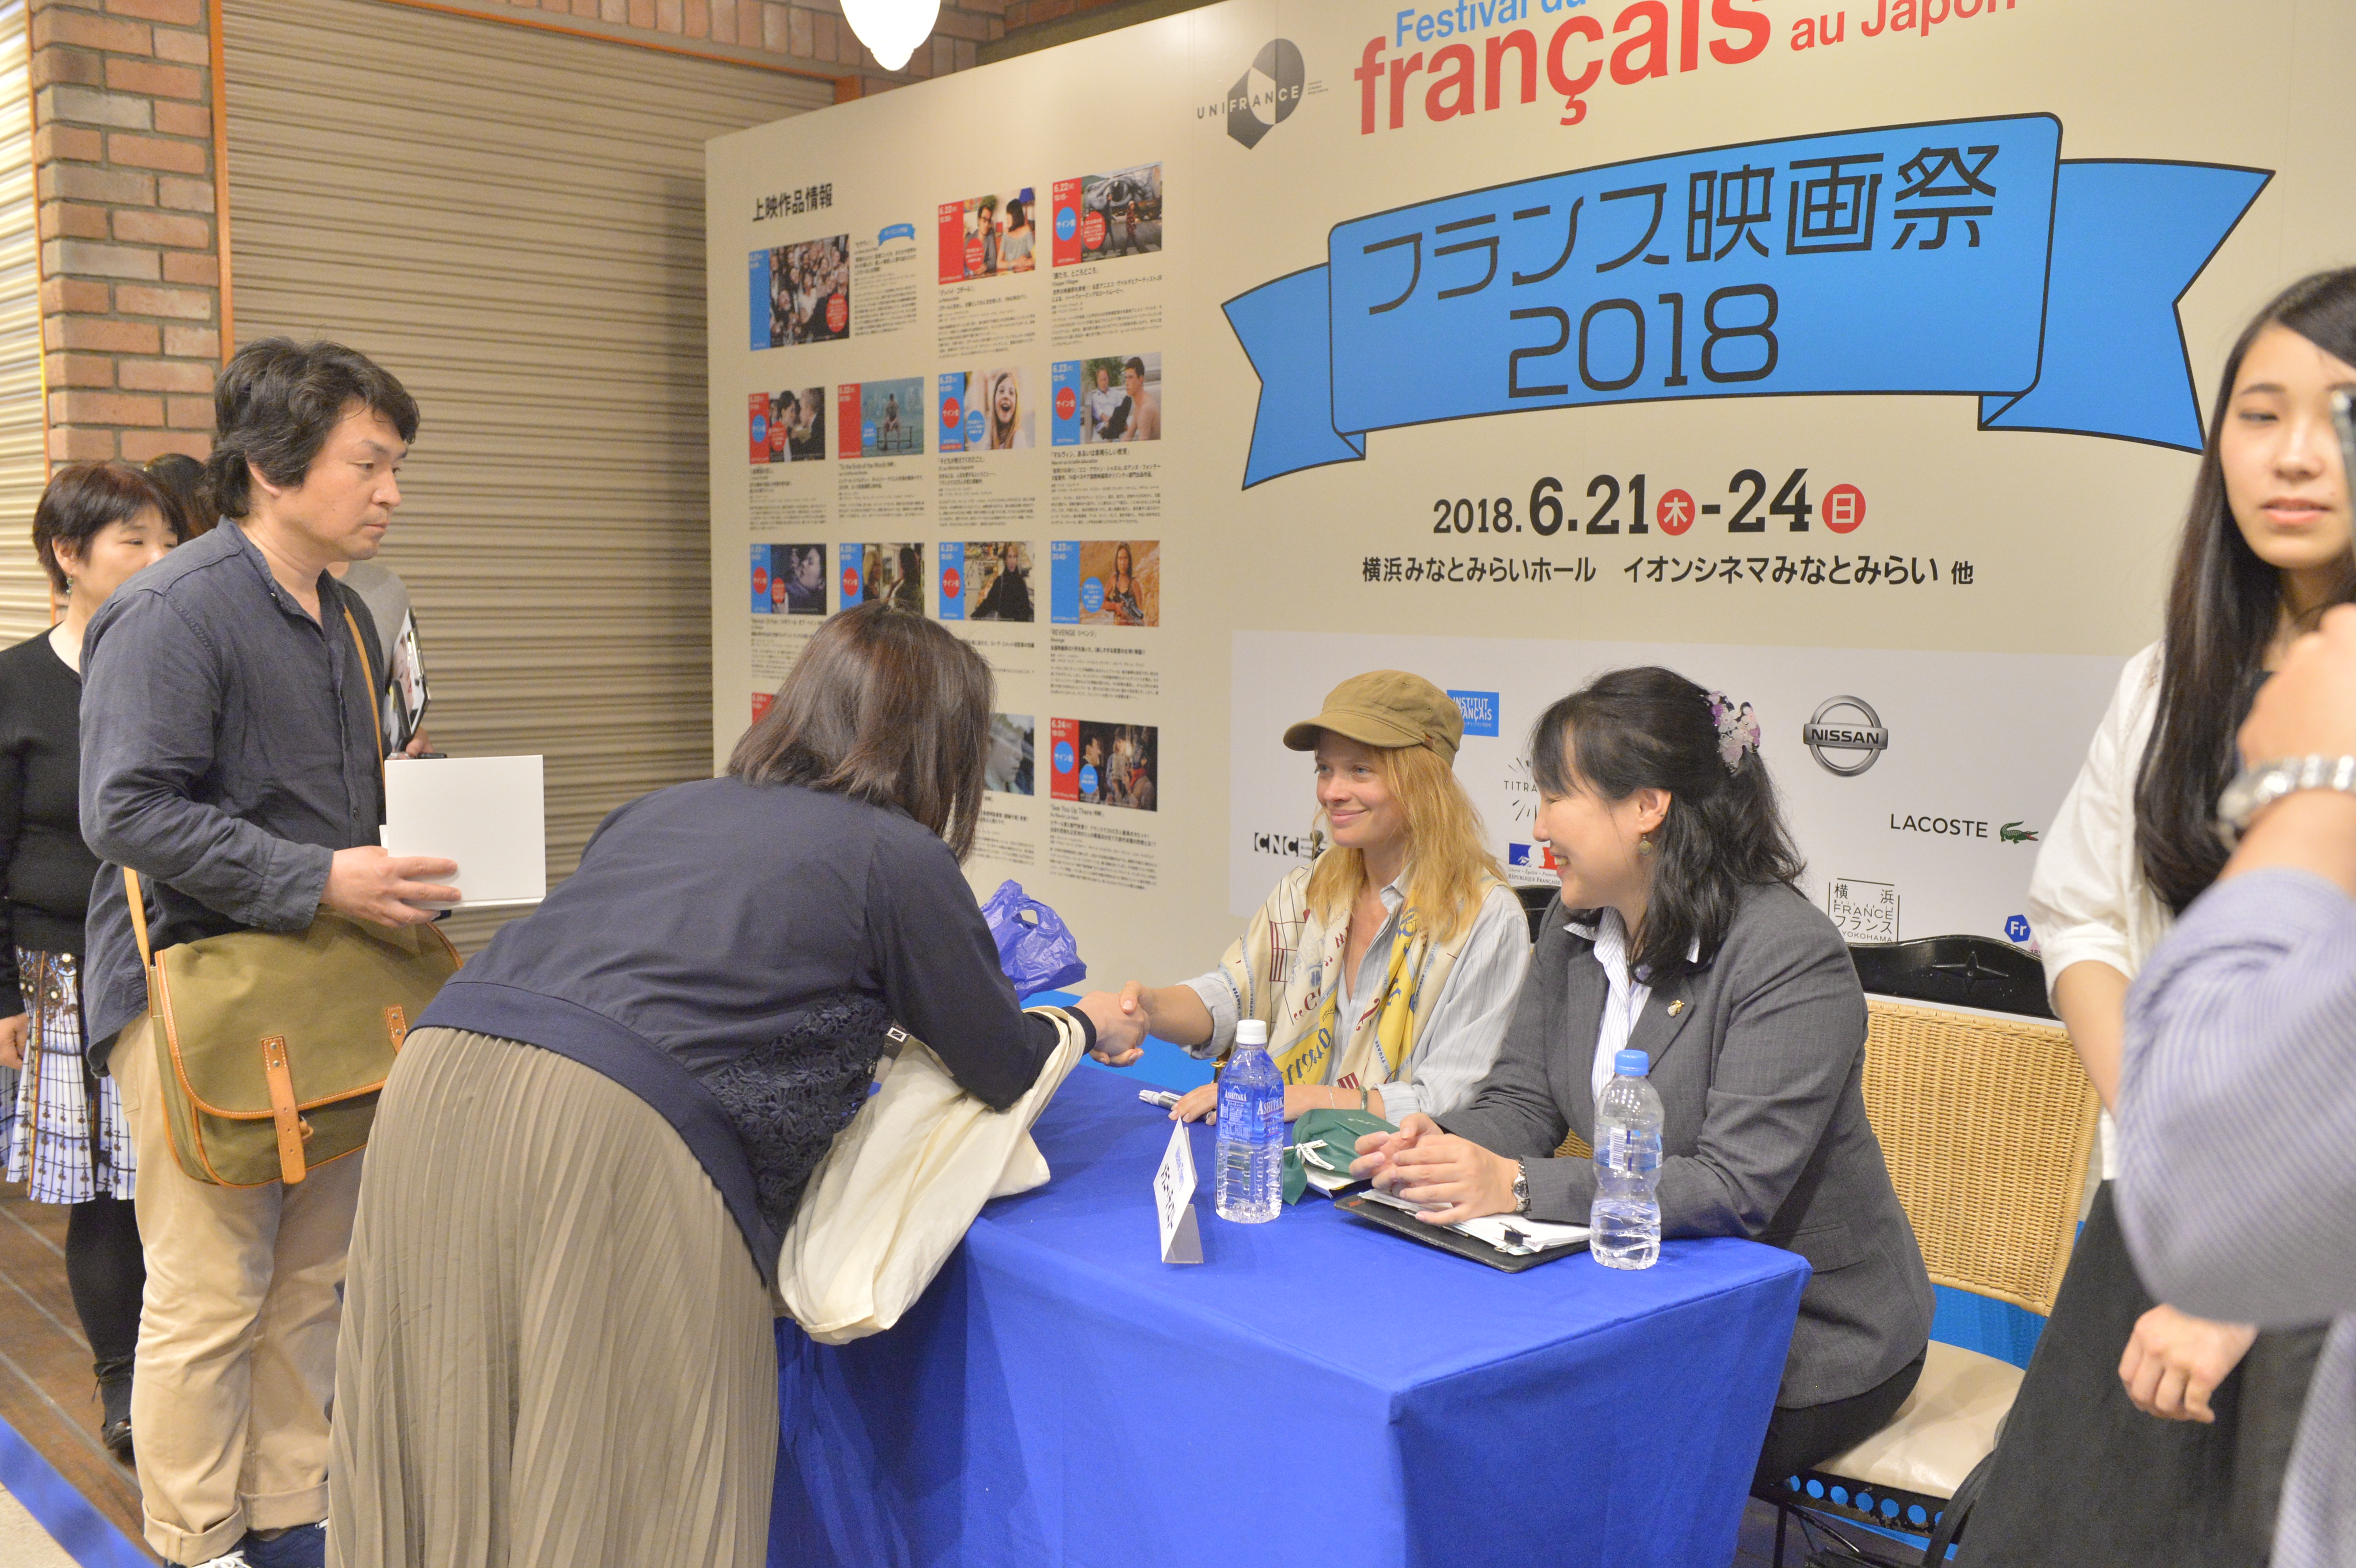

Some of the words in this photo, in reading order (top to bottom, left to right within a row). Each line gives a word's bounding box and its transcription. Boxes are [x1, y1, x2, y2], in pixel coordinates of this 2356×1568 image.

[1354, 0, 1771, 135] français
[1791, 11, 1845, 51] au
[1197, 85, 1299, 119] UNIFRANCE
[753, 183, 832, 222] 上映作品情報
[1363, 144, 1999, 315] フランス映画祭
[1508, 283, 1778, 399] 2018
[1363, 557, 1596, 583] 横浜みなとみらいホール
[1624, 555, 1938, 586] イオンシネマみなとみらい
[1951, 560, 1974, 585] 他
[1811, 729, 1879, 744] NISSAN
[1890, 813, 1988, 838] LACOSTE
[1254, 832, 1298, 857] CNC
[1834, 904, 1894, 920] FRANCE
[1835, 915, 1892, 935] フランス
[1842, 930, 1893, 942] YOKOHAMA
[2010, 920, 2028, 936] Fr
[1232, 987, 1242, 1010] BEAUTY
[1224, 1089, 1247, 1102] ASHITAKA
[1257, 1096, 1285, 1115] ASHITAK
